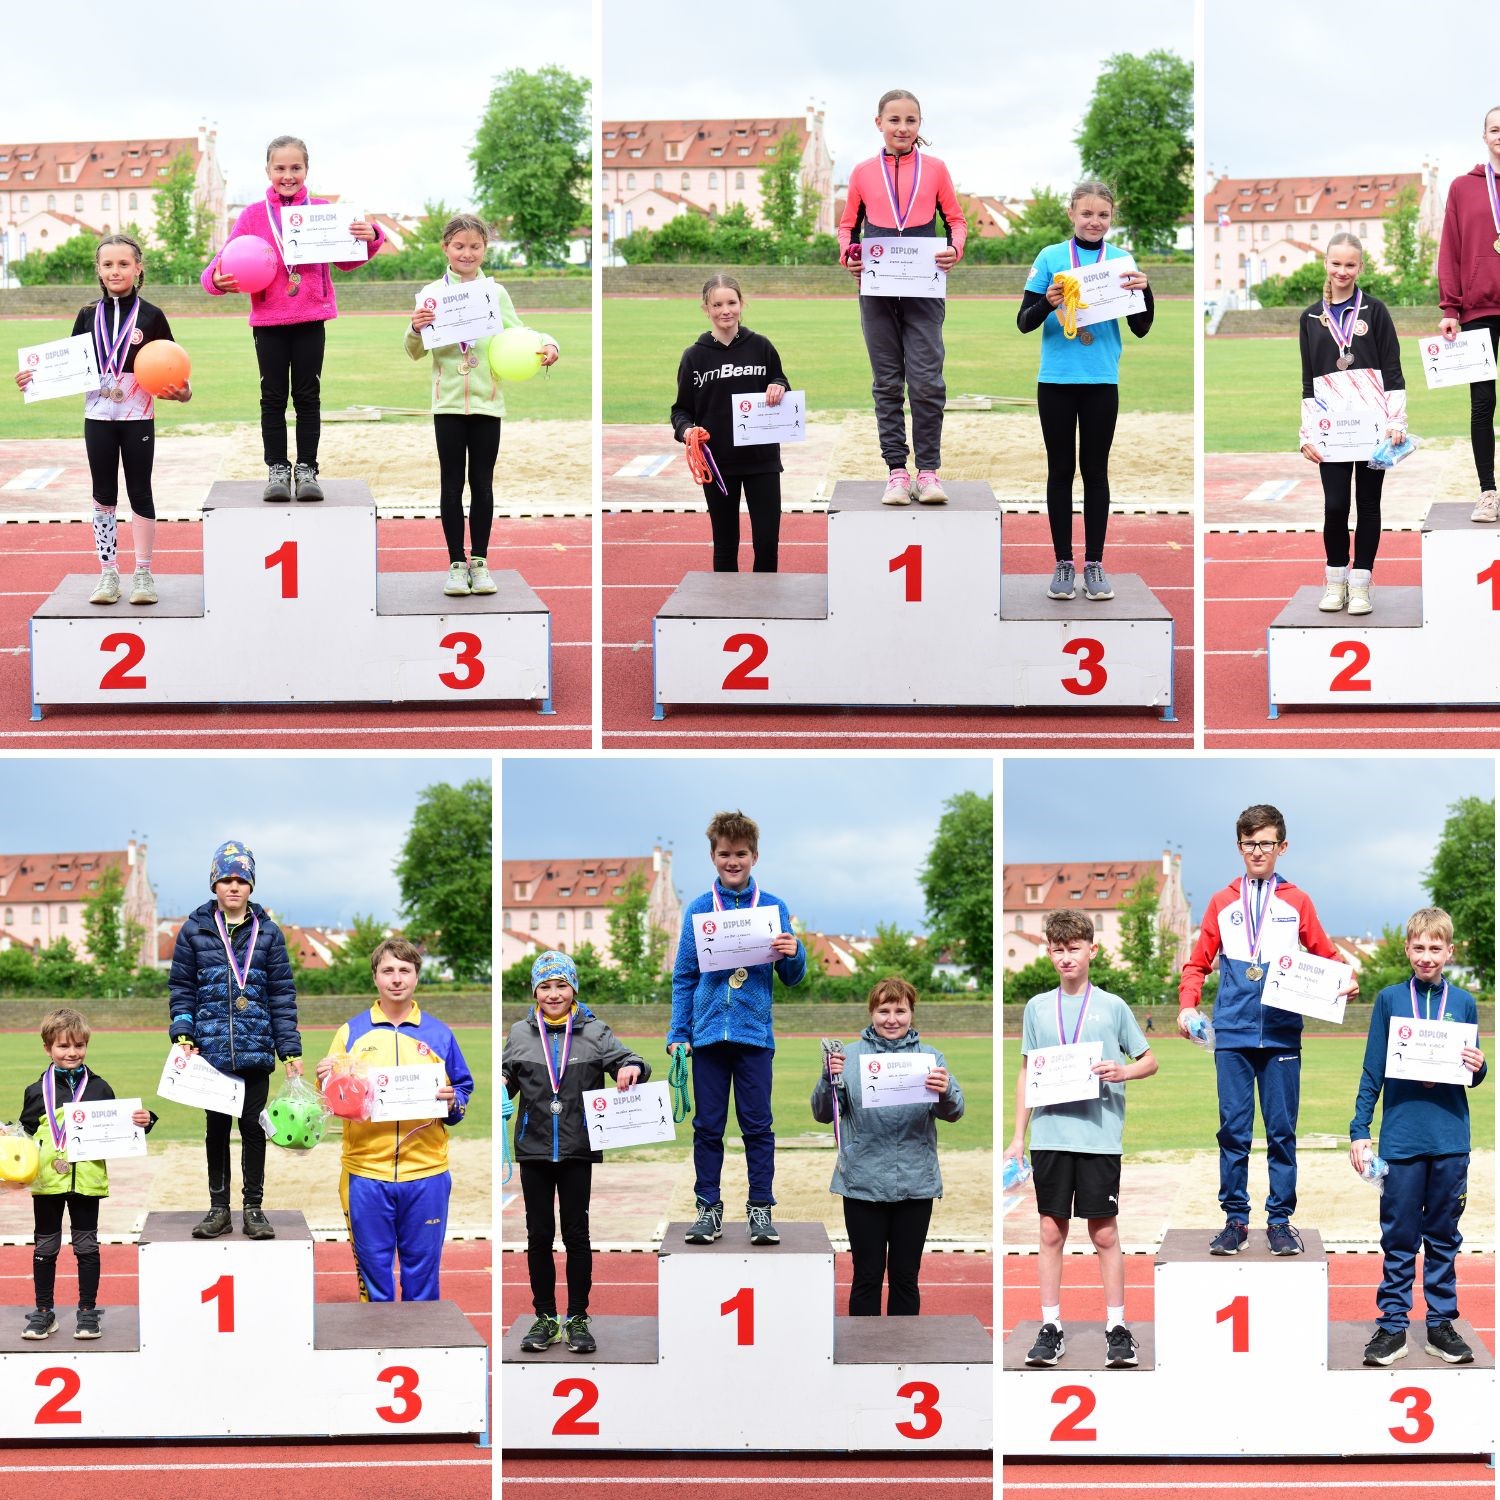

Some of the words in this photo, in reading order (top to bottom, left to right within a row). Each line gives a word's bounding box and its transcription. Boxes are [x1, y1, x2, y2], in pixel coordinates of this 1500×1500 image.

[309, 213, 337, 222] DIPLOM
[890, 246, 919, 255] DIPLOM
[1083, 271, 1110, 283] DIPLOM
[442, 292, 470, 305] DIPLOM
[45, 348, 70, 360] DIPLOM
[1444, 340, 1468, 350] DIPLOM
[1336, 419, 1361, 427] DIPLOM
[265, 541, 298, 598] 1
[889, 545, 922, 602] 1
[100, 633, 146, 689] 2
[439, 632, 485, 690] 3
[722, 633, 769, 690] 2
[1062, 638, 1107, 696] 3
[1330, 641, 1371, 691] 2
[723, 919, 752, 929] DIPLOM
[1298, 961, 1325, 976] DIPLOM
[1418, 1029, 1448, 1039] DIPLOM
[394, 1073, 420, 1082] DIPLOM
[886, 1061, 912, 1070] DIPLOM
[91, 1109, 118, 1119] DIPLOM
[613, 1094, 641, 1105] DIPLOM
[201, 1275, 234, 1332] 1
[721, 1288, 754, 1346] 1
[1216, 1296, 1249, 1352] 1
[35, 1367, 82, 1424] 2
[376, 1366, 422, 1423] 3
[552, 1378, 599, 1435] 2
[896, 1381, 942, 1439] 3
[1050, 1385, 1096, 1441] 2
[1389, 1387, 1434, 1443] 3
